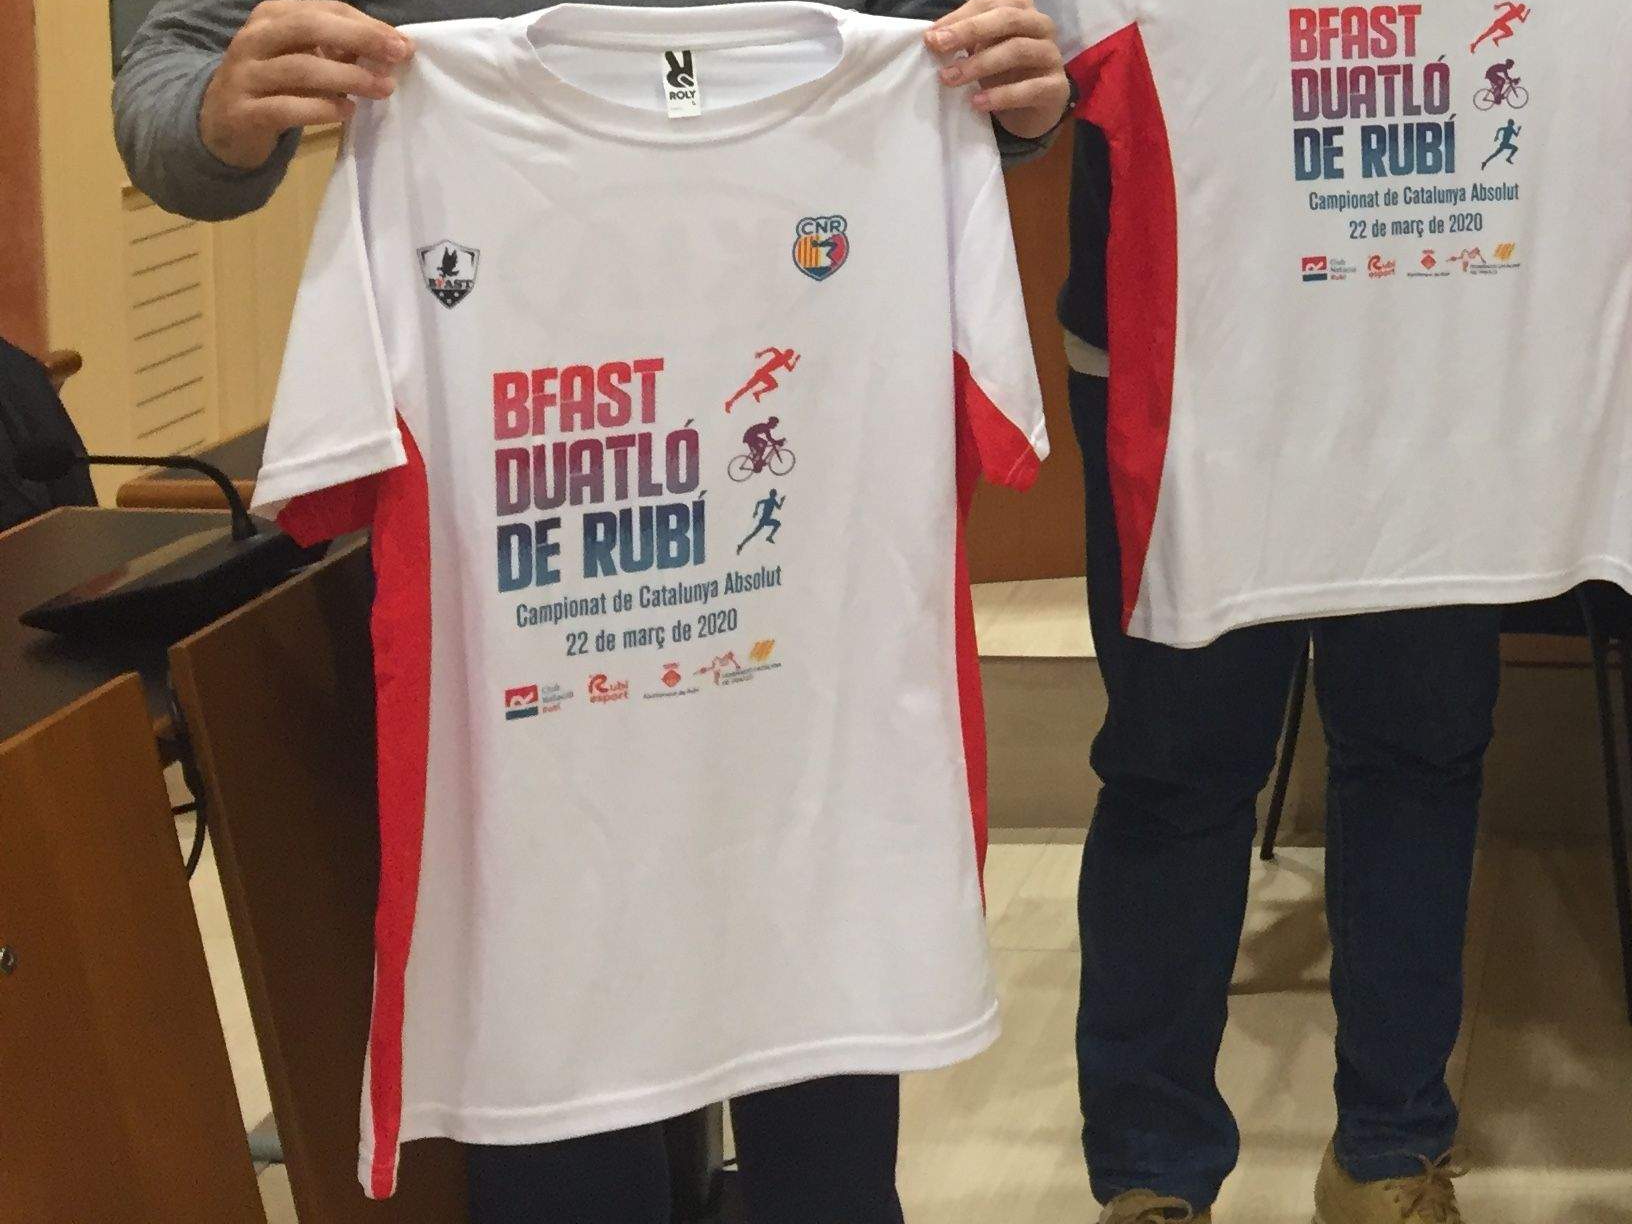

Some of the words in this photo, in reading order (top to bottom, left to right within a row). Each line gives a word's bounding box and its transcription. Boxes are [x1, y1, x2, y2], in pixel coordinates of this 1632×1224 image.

[1289, 4, 1422, 62] BFAST
[669, 90, 696, 100] ROLY
[1291, 54, 1450, 121] DUATLÓ
[1294, 126, 1344, 181] DE
[1361, 113, 1456, 178] RUBÍ
[801, 220, 841, 234] CNR
[1309, 191, 1380, 212] Campionat
[1384, 189, 1398, 206] de
[1404, 186, 1466, 207] Catalunya
[1471, 182, 1519, 202] Absolut
[1349, 220, 1367, 239] 22
[1372, 219, 1387, 237] de
[1391, 220, 1424, 237] març
[1429, 217, 1444, 234] de
[1449, 212, 1483, 233] 2020
[493, 358, 664, 441] BFAST
[495, 418, 700, 516] DUATLÓ
[497, 517, 561, 593] DE
[583, 490, 707, 578] RUBÍ
[516, 595, 607, 628] Campionat
[613, 589, 633, 612] de
[639, 578, 719, 608] Catalunya
[723, 565, 782, 595] Absolut
[566, 630, 588, 656] 22
[596, 631, 616, 653] de
[623, 626, 665, 650] març
[672, 620, 692, 643] de
[698, 608, 738, 638] 2020
